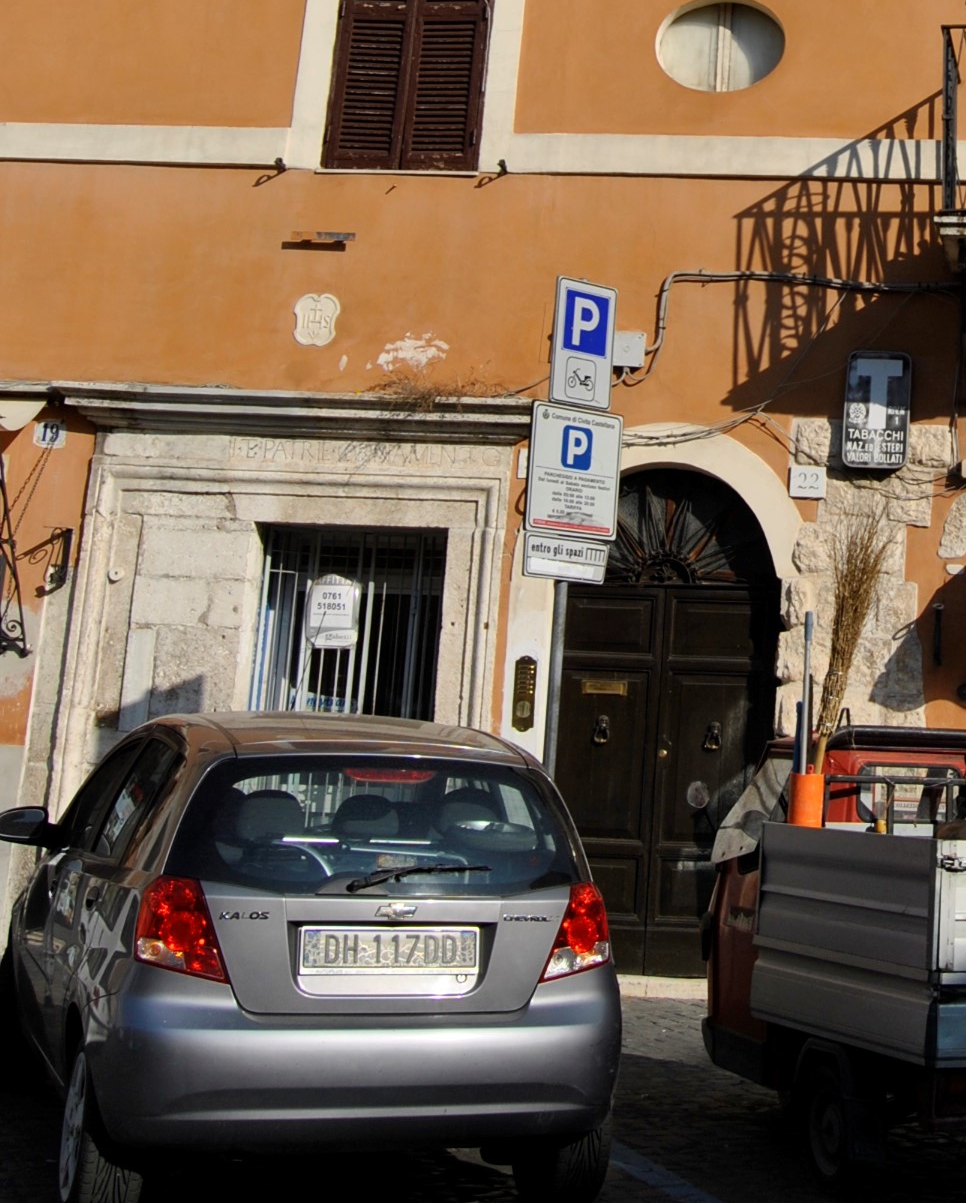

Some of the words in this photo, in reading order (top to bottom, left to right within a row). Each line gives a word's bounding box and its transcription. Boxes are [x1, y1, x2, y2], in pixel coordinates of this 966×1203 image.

[572, 296, 600, 347] P
[857, 358, 904, 430] T
[552, 412, 571, 422] Comune
[41, 422, 60, 443] 19
[848, 428, 904, 441] TABACCHI
[566, 429, 588, 465] P
[877, 442, 903, 453] ESTERI
[847, 452, 872, 463] VALORI
[873, 453, 903, 464] BOLLATI
[797, 472, 819, 490] 22
[531, 542, 551, 554] entro
[553, 544, 564, 557] gli
[565, 546, 584, 559] spazi
[322, 592, 342, 600] 0761
[317, 602, 346, 611] 518051
[218, 911, 270, 920] KALOS
[324, 934, 359, 964] DH
[373, 934, 458, 964] 117DD
